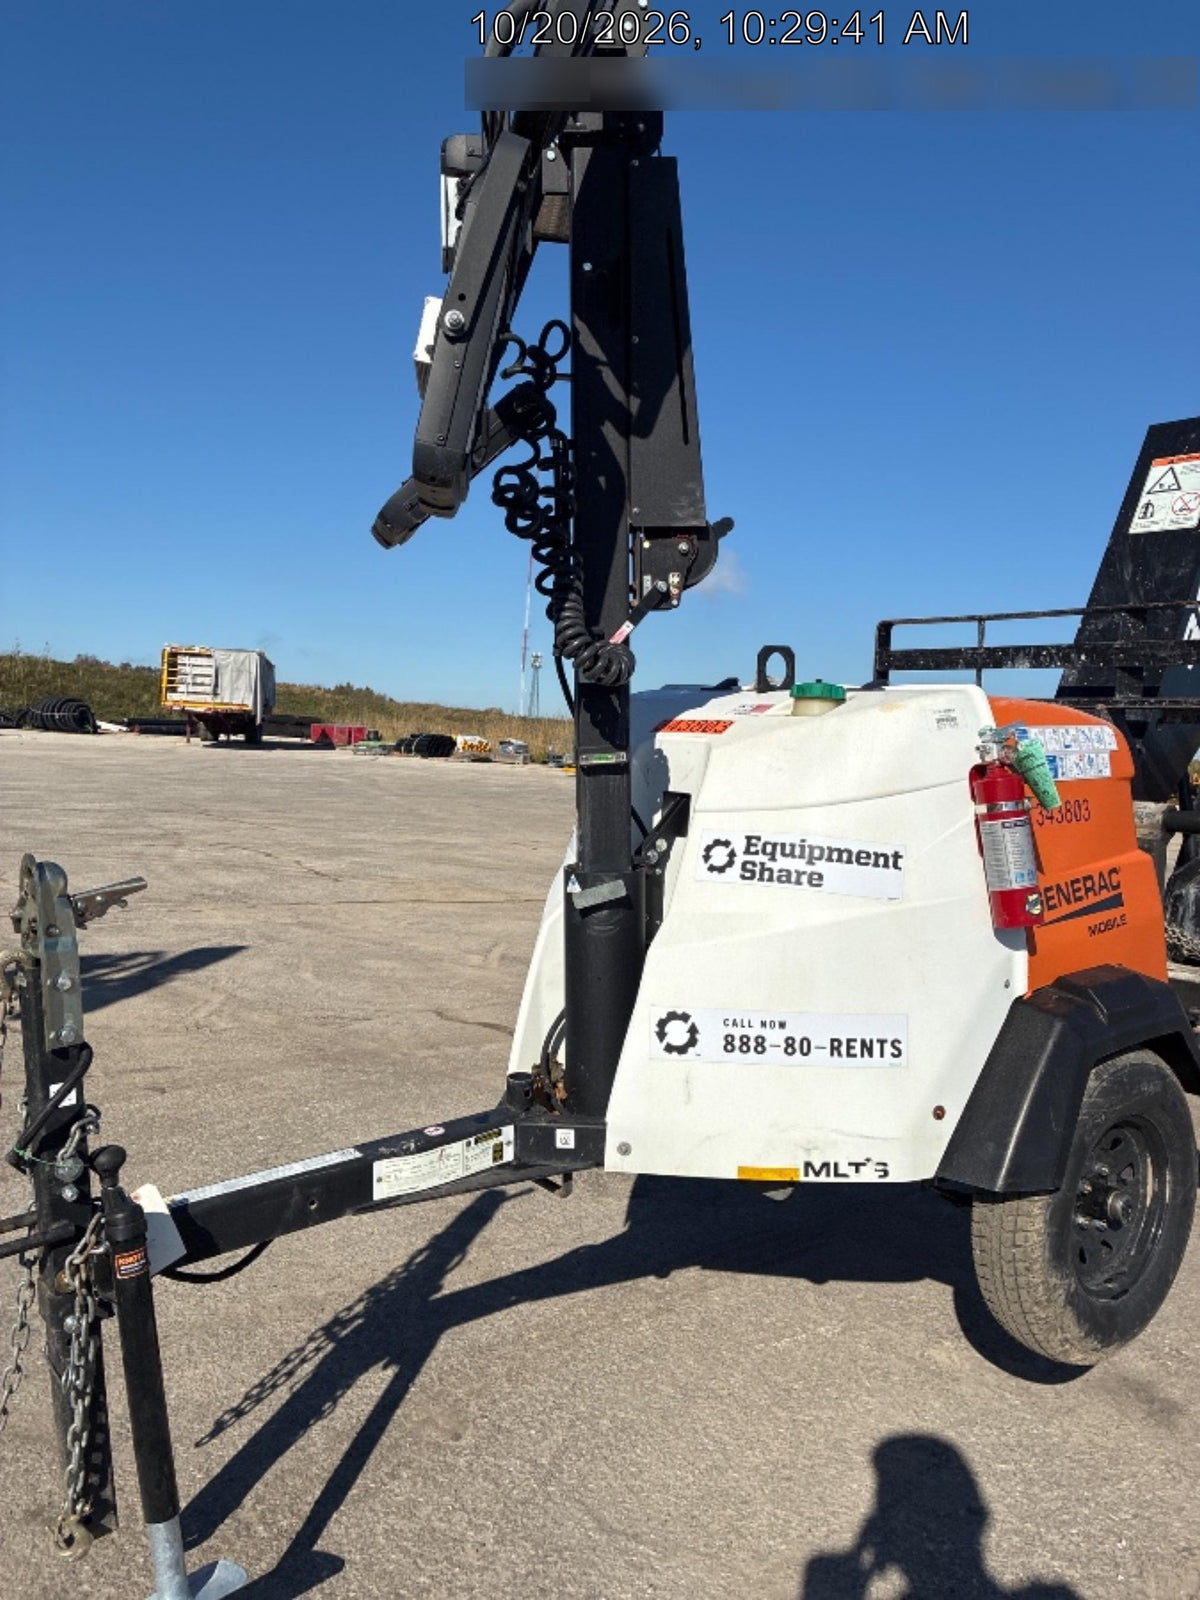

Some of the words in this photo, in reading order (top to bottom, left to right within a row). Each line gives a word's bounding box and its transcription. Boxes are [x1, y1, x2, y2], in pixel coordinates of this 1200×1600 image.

[743, 835, 903, 871] Equipment
[739, 860, 824, 887] Share
[723, 1018, 753, 1028] CALL
[760, 1020, 787, 1030] NOW
[723, 1034, 903, 1058] 888-80-RENTS
